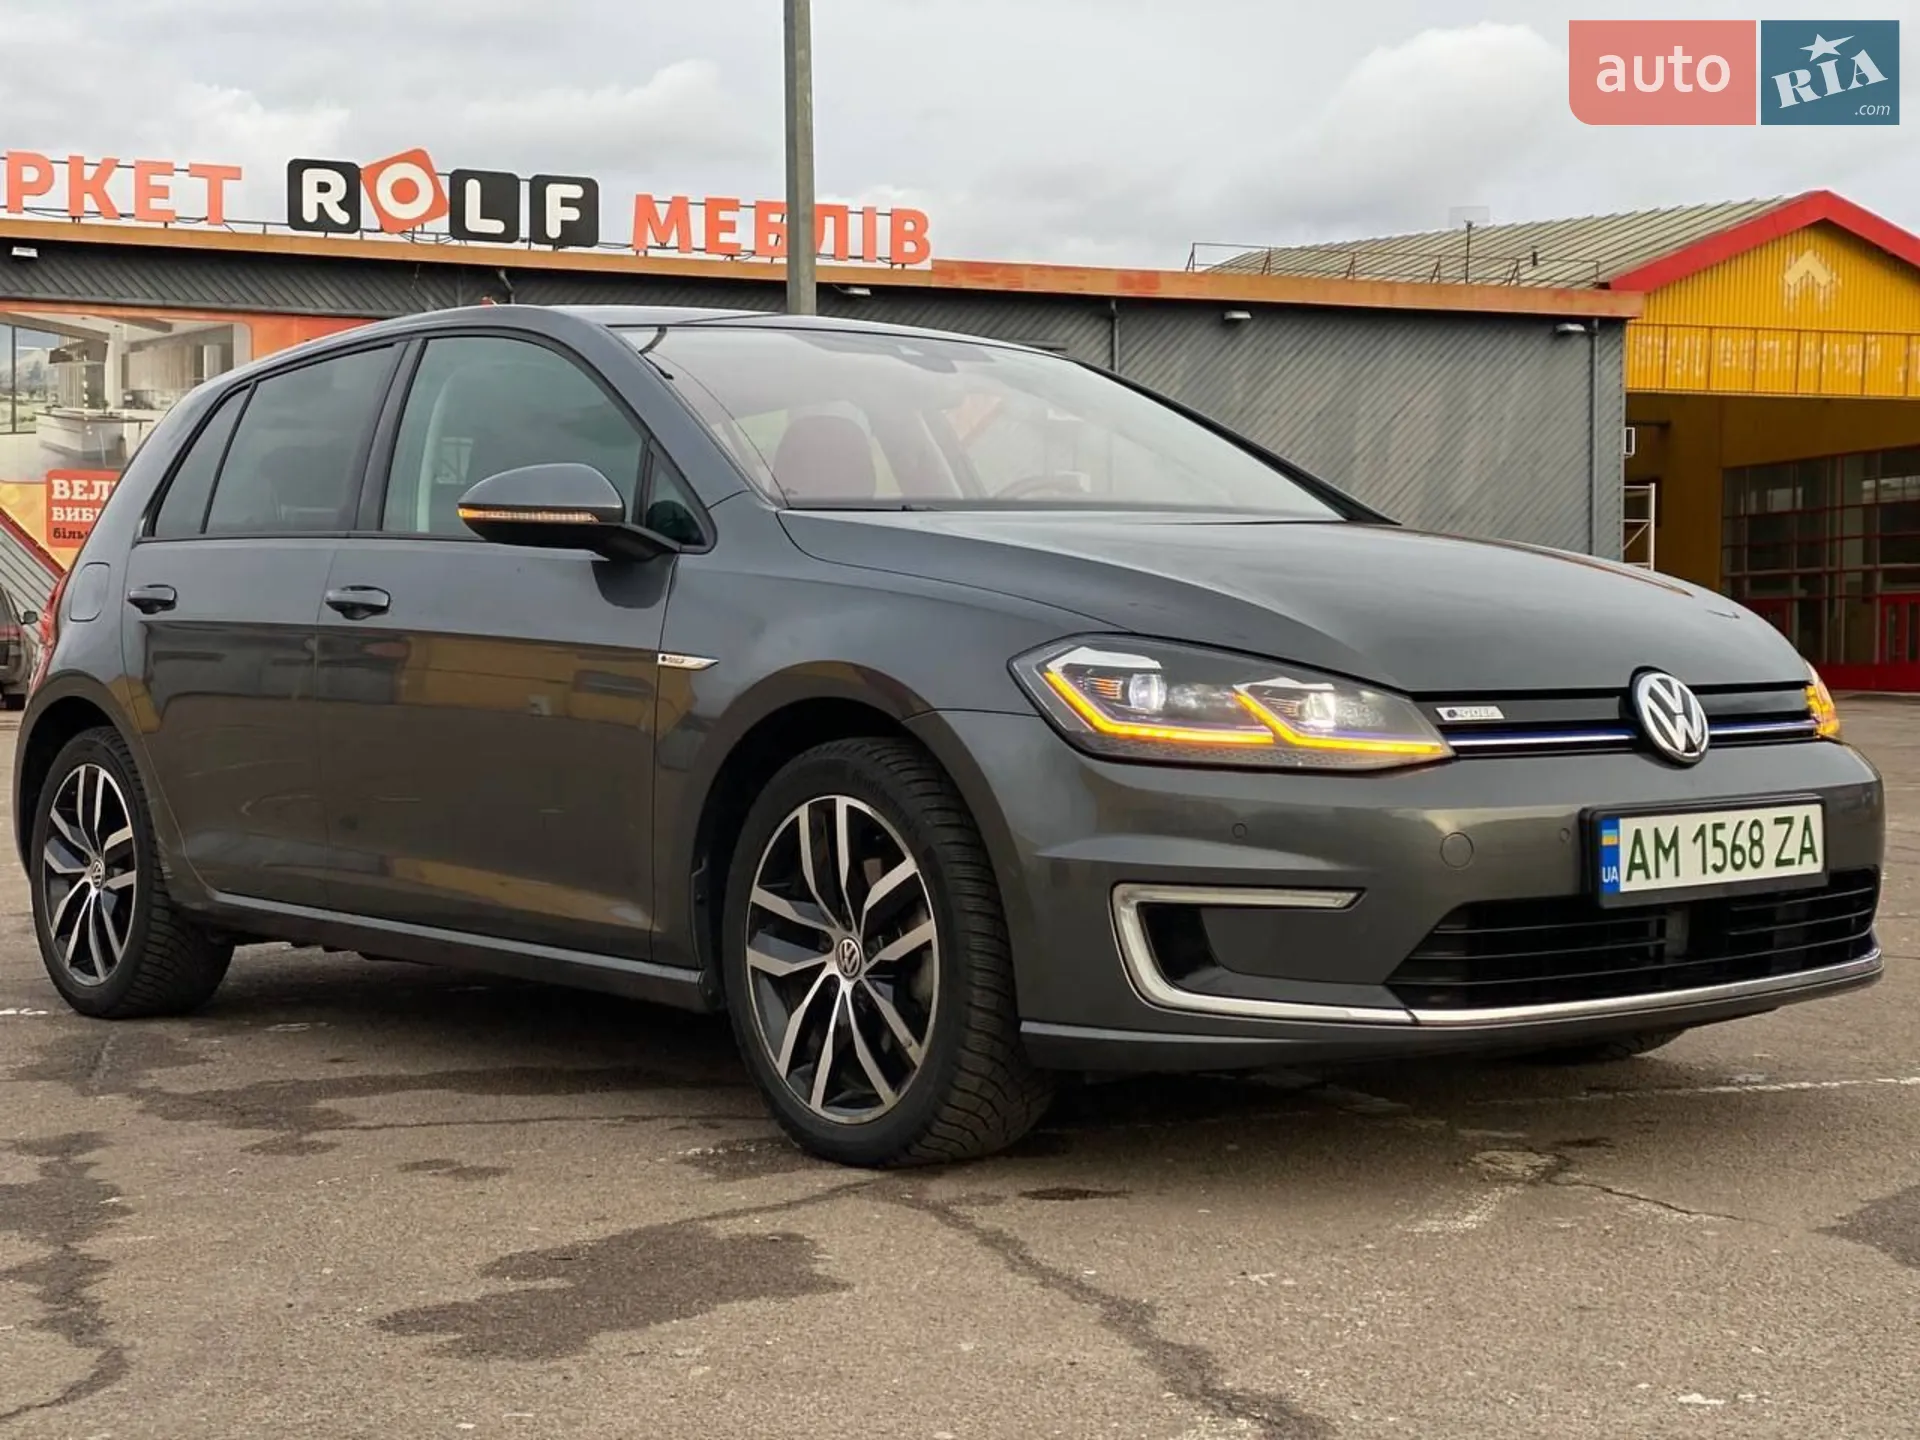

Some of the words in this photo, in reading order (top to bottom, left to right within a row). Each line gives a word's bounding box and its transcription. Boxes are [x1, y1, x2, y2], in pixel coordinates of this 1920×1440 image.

[7, 151, 242, 226] РКЕТ
[301, 161, 584, 240] ROLF
[632, 193, 931, 264] МЕБЛІВ
[51, 479, 119, 501] ВЕЛ
[52, 527, 89, 540] біль
[1602, 866, 1620, 883] UA
[1626, 825, 1681, 882] AM
[1692, 819, 1765, 876] 1568
[1774, 815, 1818, 868] ZA
